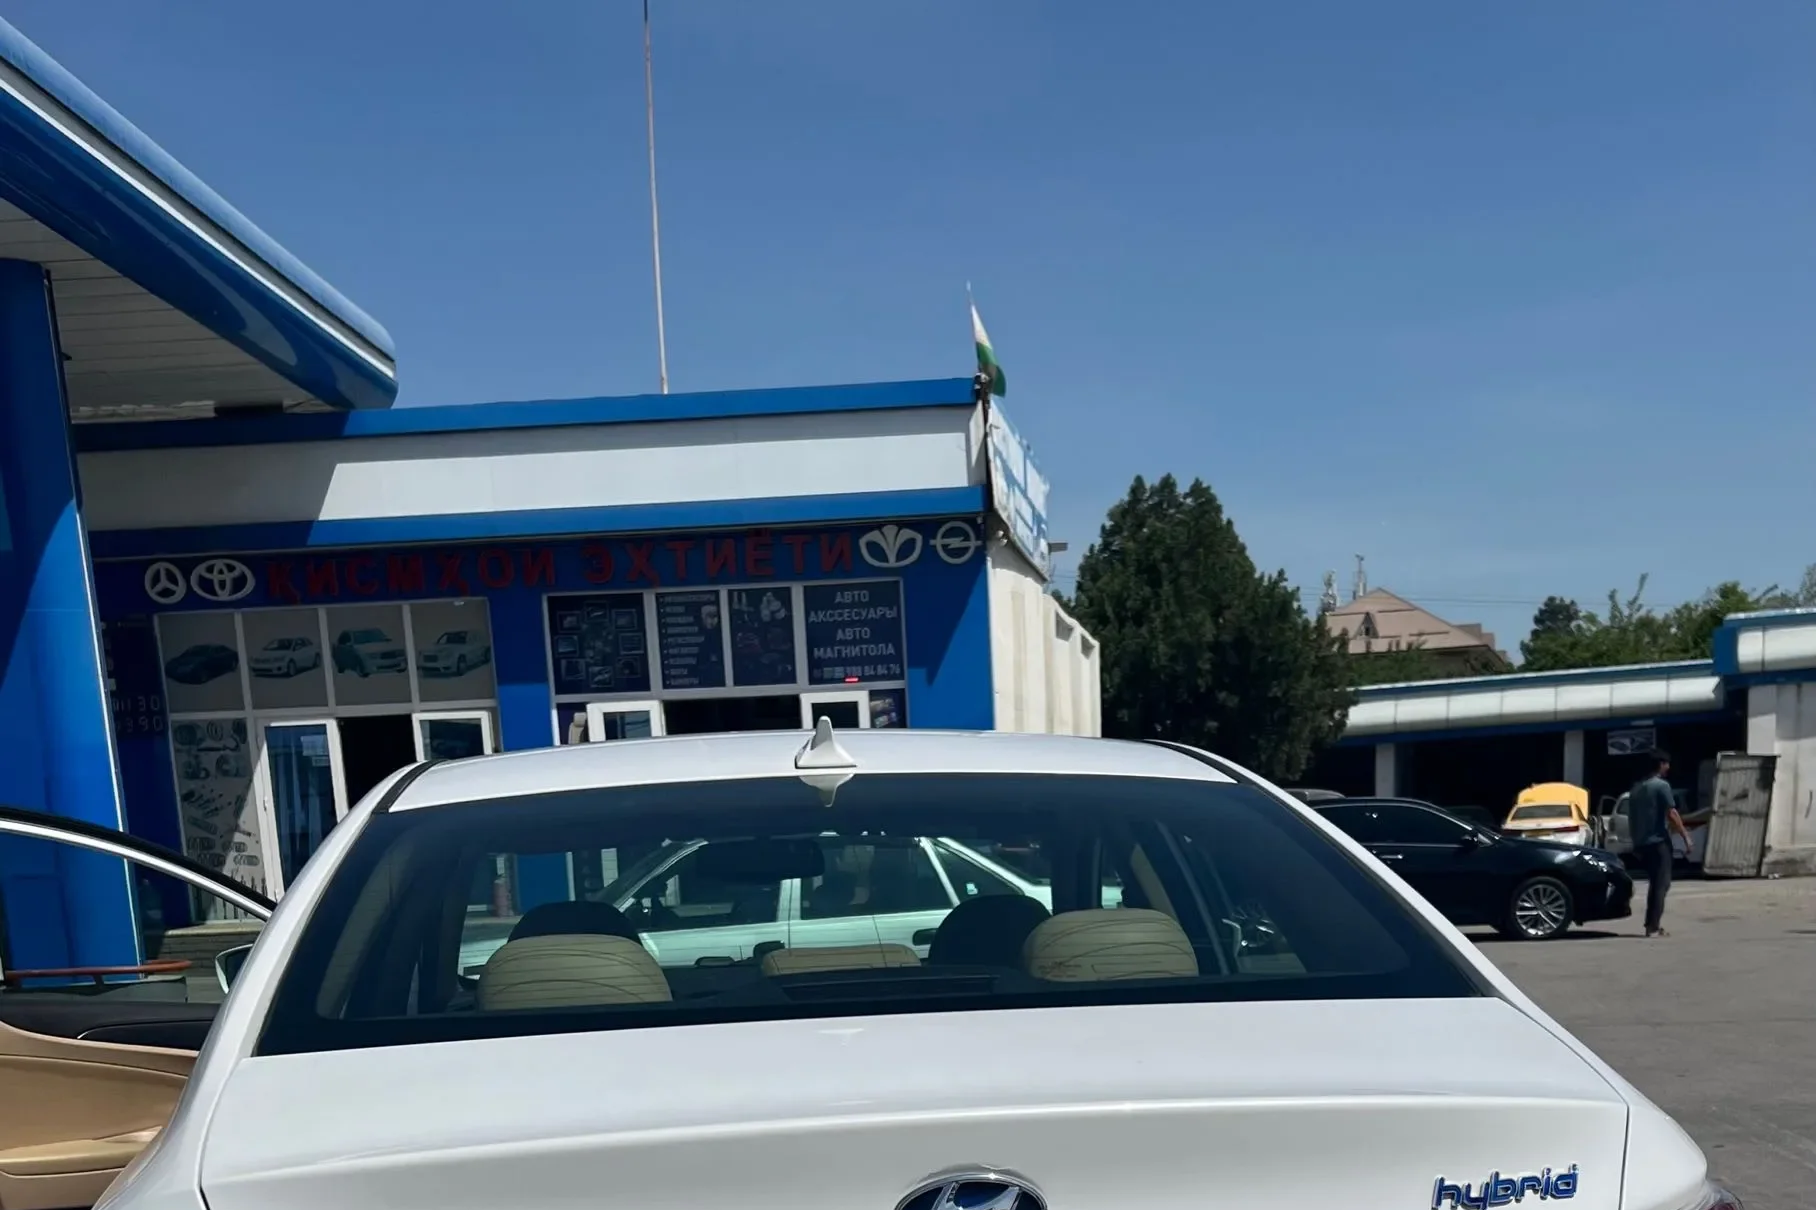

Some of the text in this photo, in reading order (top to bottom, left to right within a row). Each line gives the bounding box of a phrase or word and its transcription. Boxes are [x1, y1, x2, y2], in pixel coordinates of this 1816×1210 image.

[583, 529, 854, 587] ЭҲТИЁТИ
[834, 590, 870, 603] АВТО
[808, 605, 898, 623] АКССЕСУАРЫ
[836, 627, 871, 641] АВТО
[813, 643, 896, 659] МАГНИТОЛА
